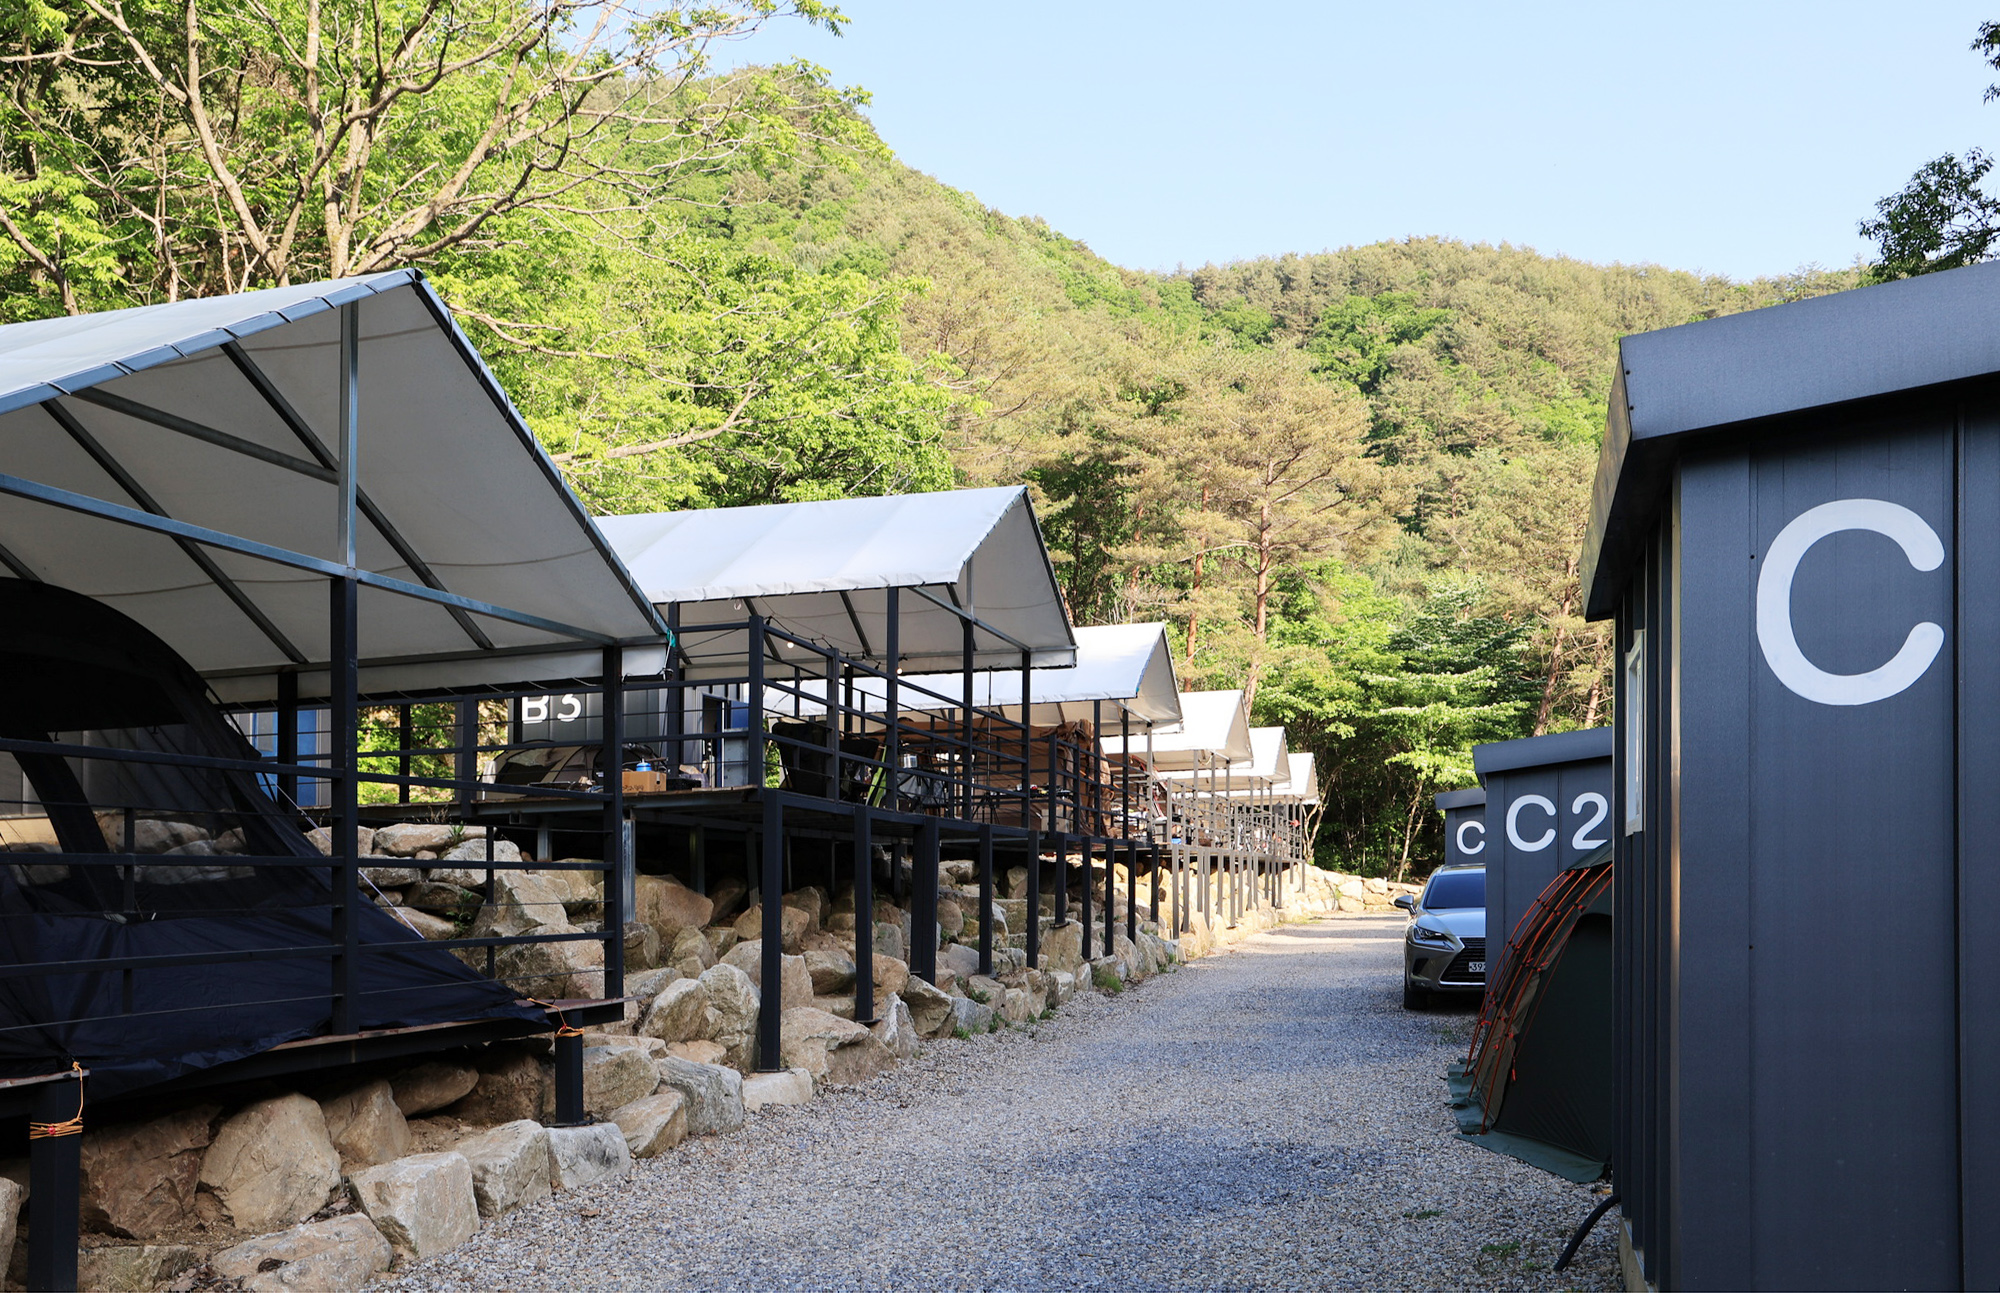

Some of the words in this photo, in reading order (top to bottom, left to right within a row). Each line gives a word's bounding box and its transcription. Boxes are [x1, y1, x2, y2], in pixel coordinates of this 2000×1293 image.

[1756, 498, 1945, 706] C
[1456, 820, 1486, 854] C
[1506, 792, 1609, 852] C2
